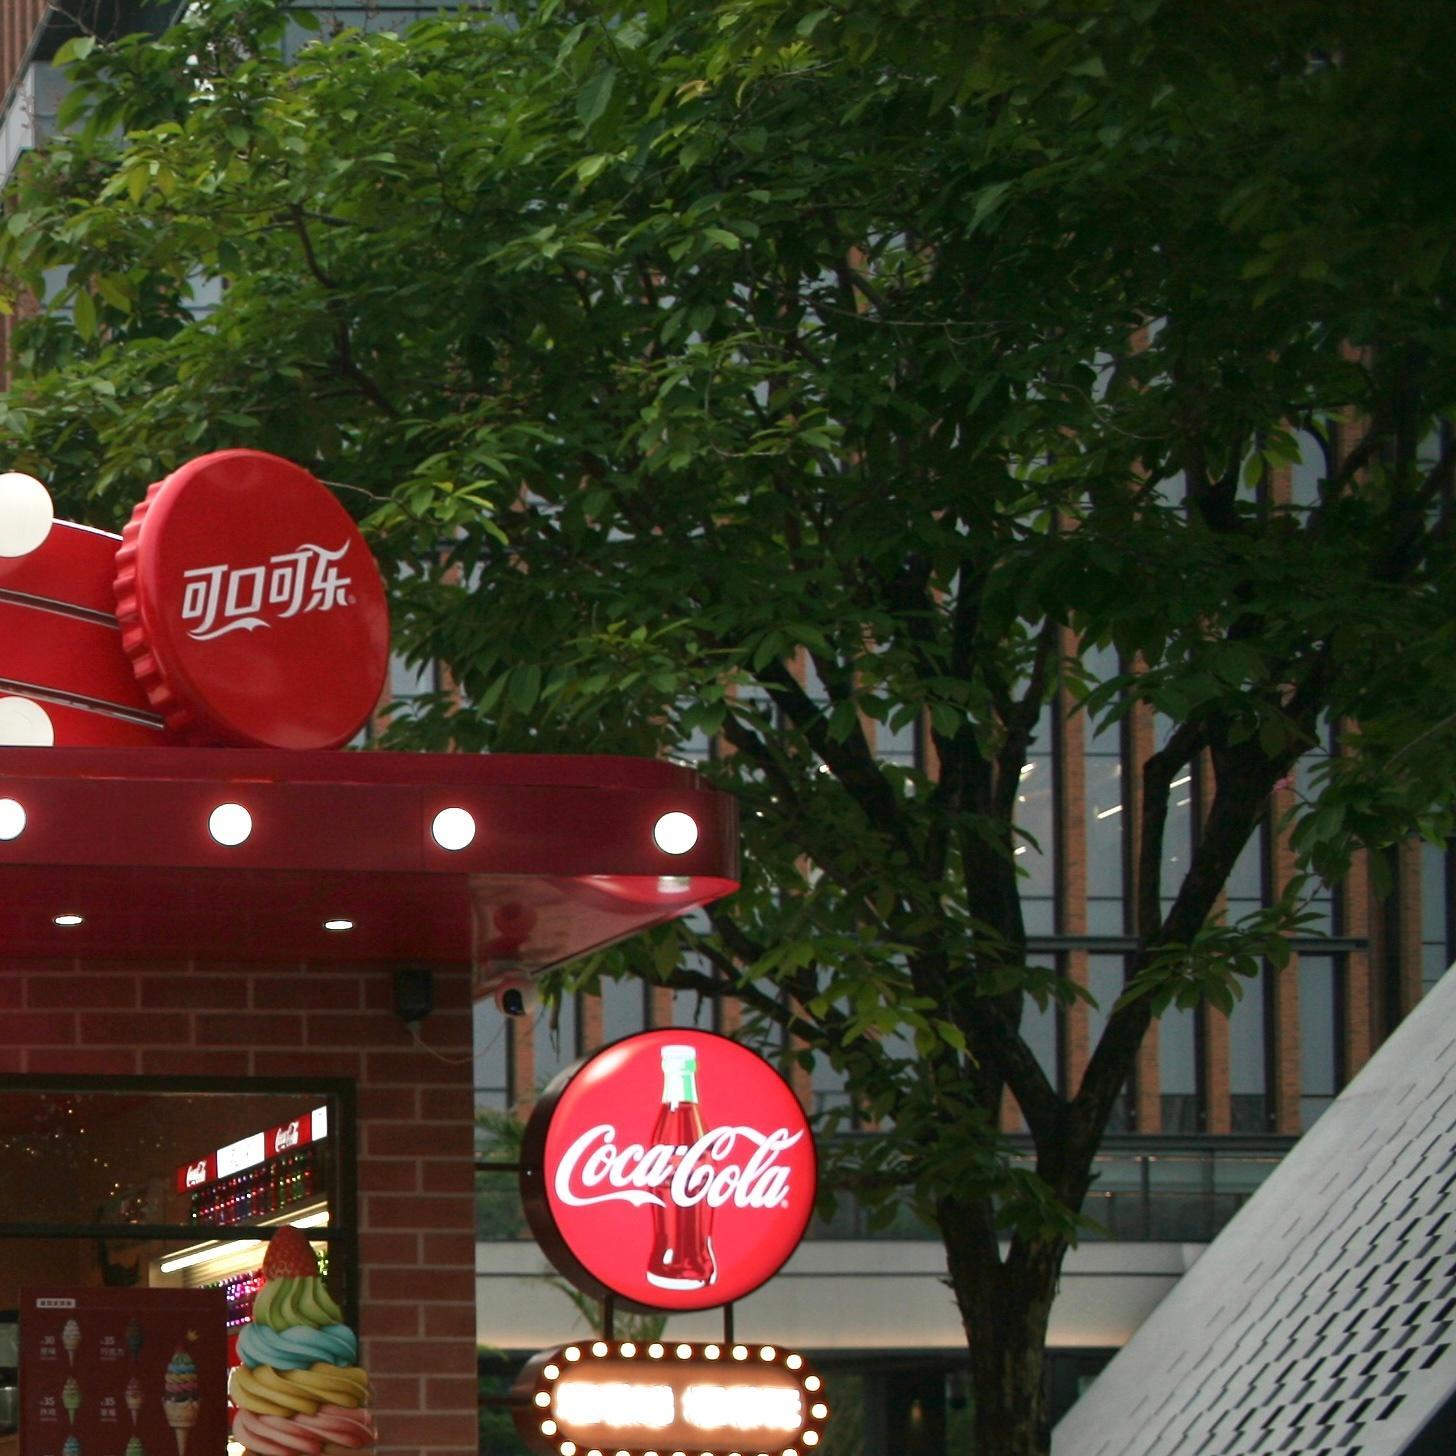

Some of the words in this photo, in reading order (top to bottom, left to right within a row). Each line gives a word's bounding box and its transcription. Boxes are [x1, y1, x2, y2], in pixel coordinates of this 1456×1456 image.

[182, 538, 351, 641] 可口可乐
[554, 1123, 804, 1210] Coca-Cola
